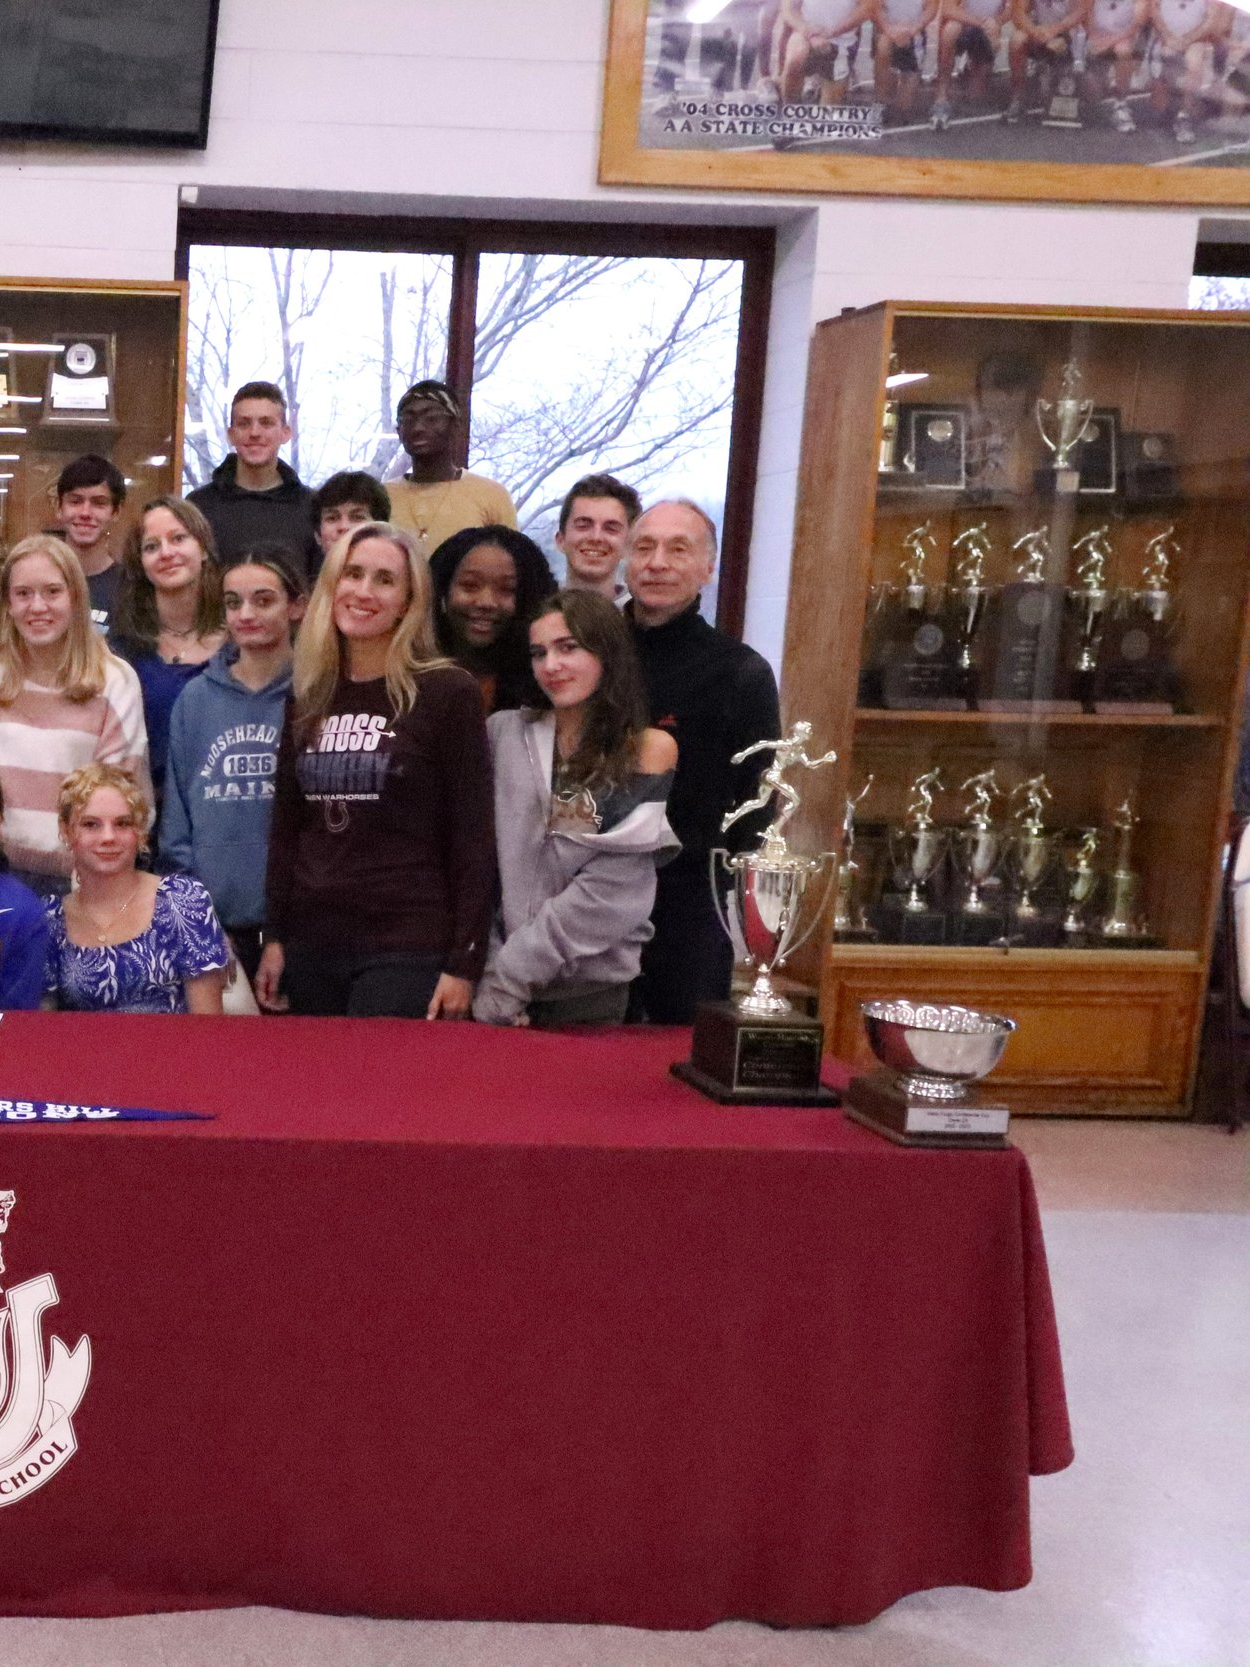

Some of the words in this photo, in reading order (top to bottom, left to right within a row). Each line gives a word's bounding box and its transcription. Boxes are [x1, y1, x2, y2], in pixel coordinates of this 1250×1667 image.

[715, 103, 777, 118] CROSS
[783, 105, 871, 120] COUNTRY
[701, 120, 764, 135] STATE
[768, 121, 882, 139] CHAMPIONS
[227, 755, 273, 775] 1836
